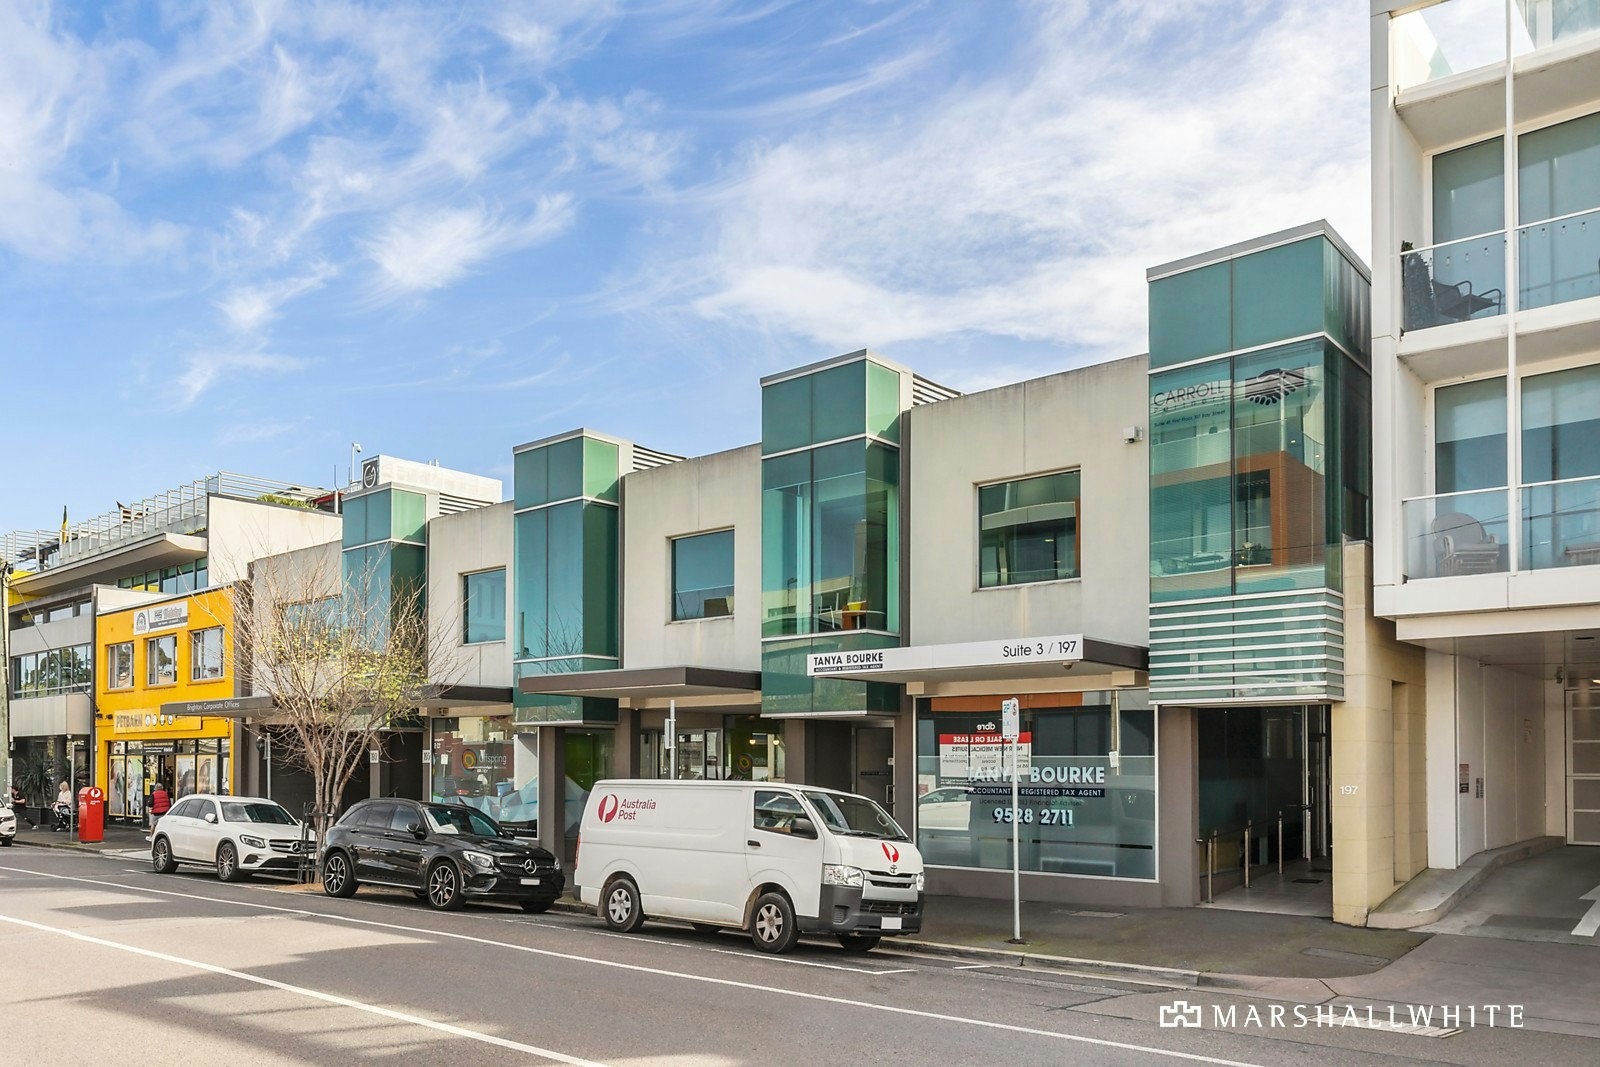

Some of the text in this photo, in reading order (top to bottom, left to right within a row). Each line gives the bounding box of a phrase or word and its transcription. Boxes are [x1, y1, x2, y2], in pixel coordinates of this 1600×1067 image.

[1153, 380, 1225, 406] CARROLL
[1002, 640, 1077, 657] Suite 3 / 197
[813, 652, 883, 666] TANYA BOURKE
[186, 700, 240, 713] Brighton Corporate Offices
[1029, 767, 1104, 784] BOURKE
[1020, 788, 1060, 797] REGISTERED
[1062, 788, 1076, 797] TAX
[1078, 789, 1101, 797] AGENT
[1339, 785, 1358, 795] 197
[620, 798, 657, 810] Australia
[617, 809, 637, 820] Post
[993, 807, 1074, 825] 9528 2711
